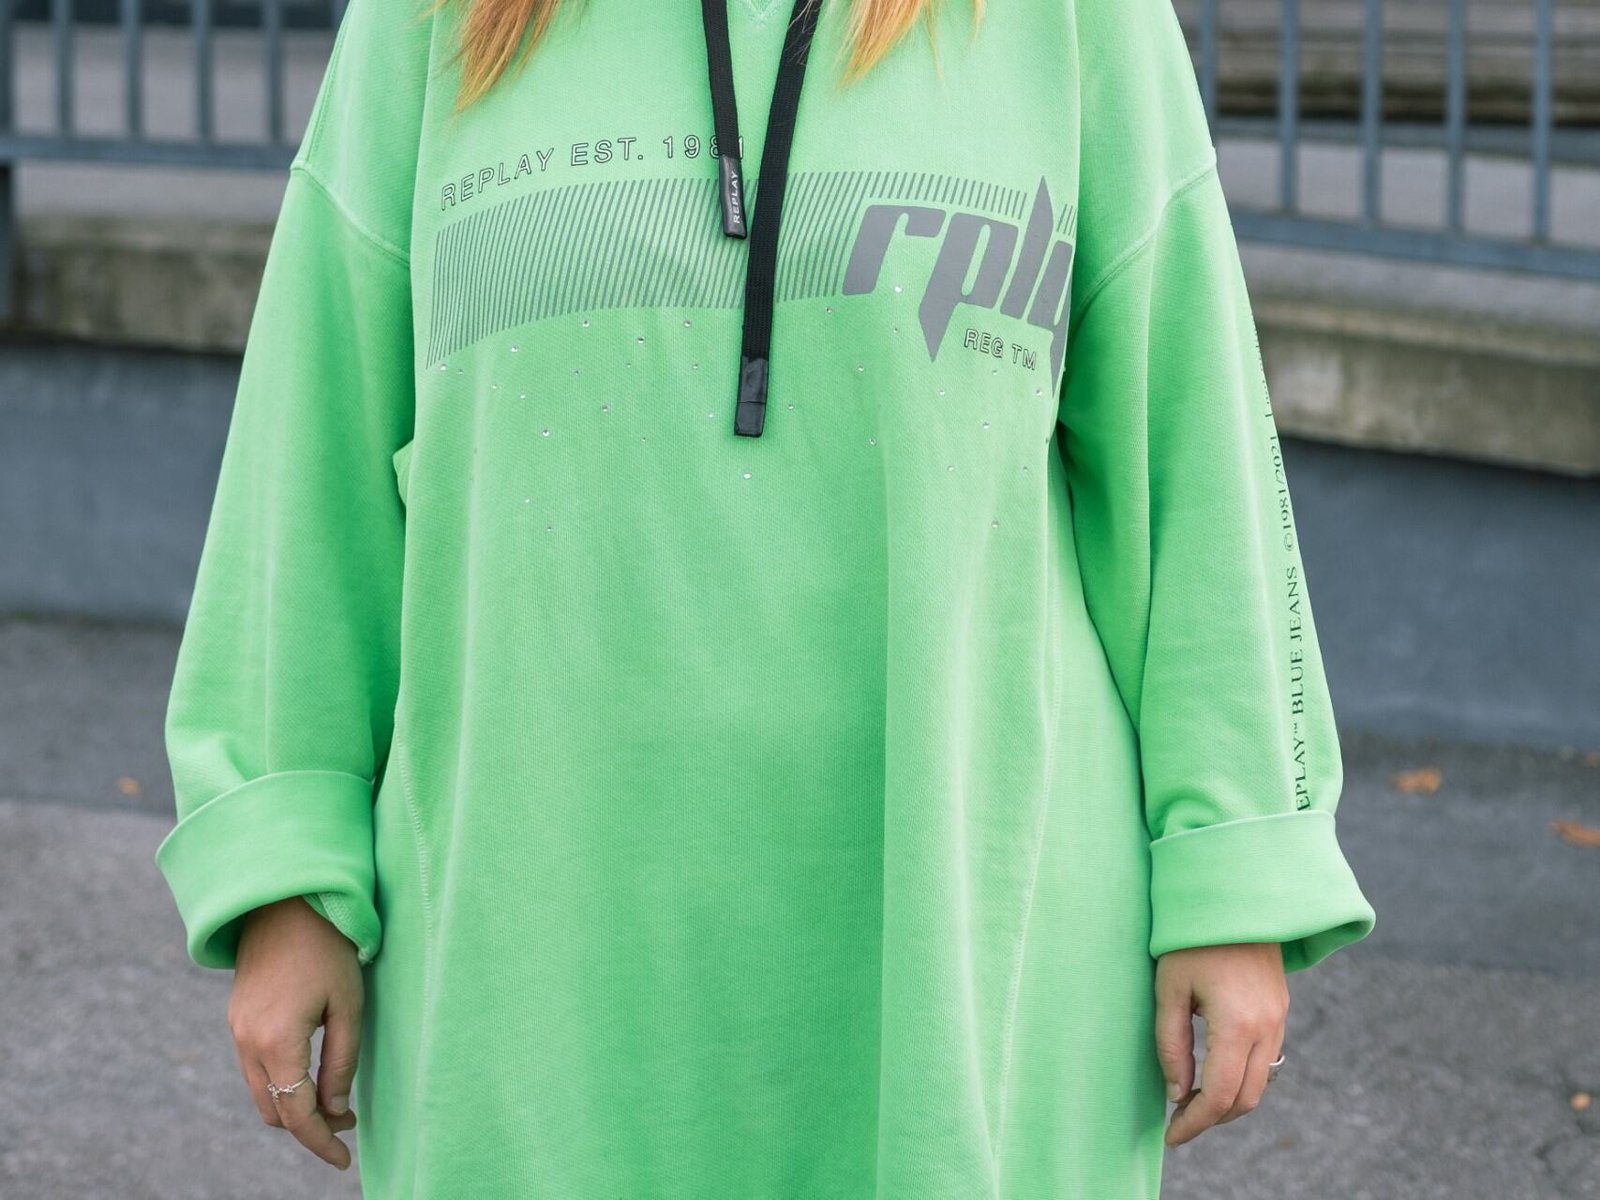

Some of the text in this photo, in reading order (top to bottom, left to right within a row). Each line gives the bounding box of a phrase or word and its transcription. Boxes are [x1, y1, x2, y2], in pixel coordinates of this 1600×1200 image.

[441, 147, 554, 211] REPLAY
[570, 136, 644, 167] EST.
[730, 170, 740, 224] REPLAY
[963, 328, 1037, 371] REG TM
[1286, 566, 1302, 642] JEANS
[1290, 649, 1304, 714] BLUE
